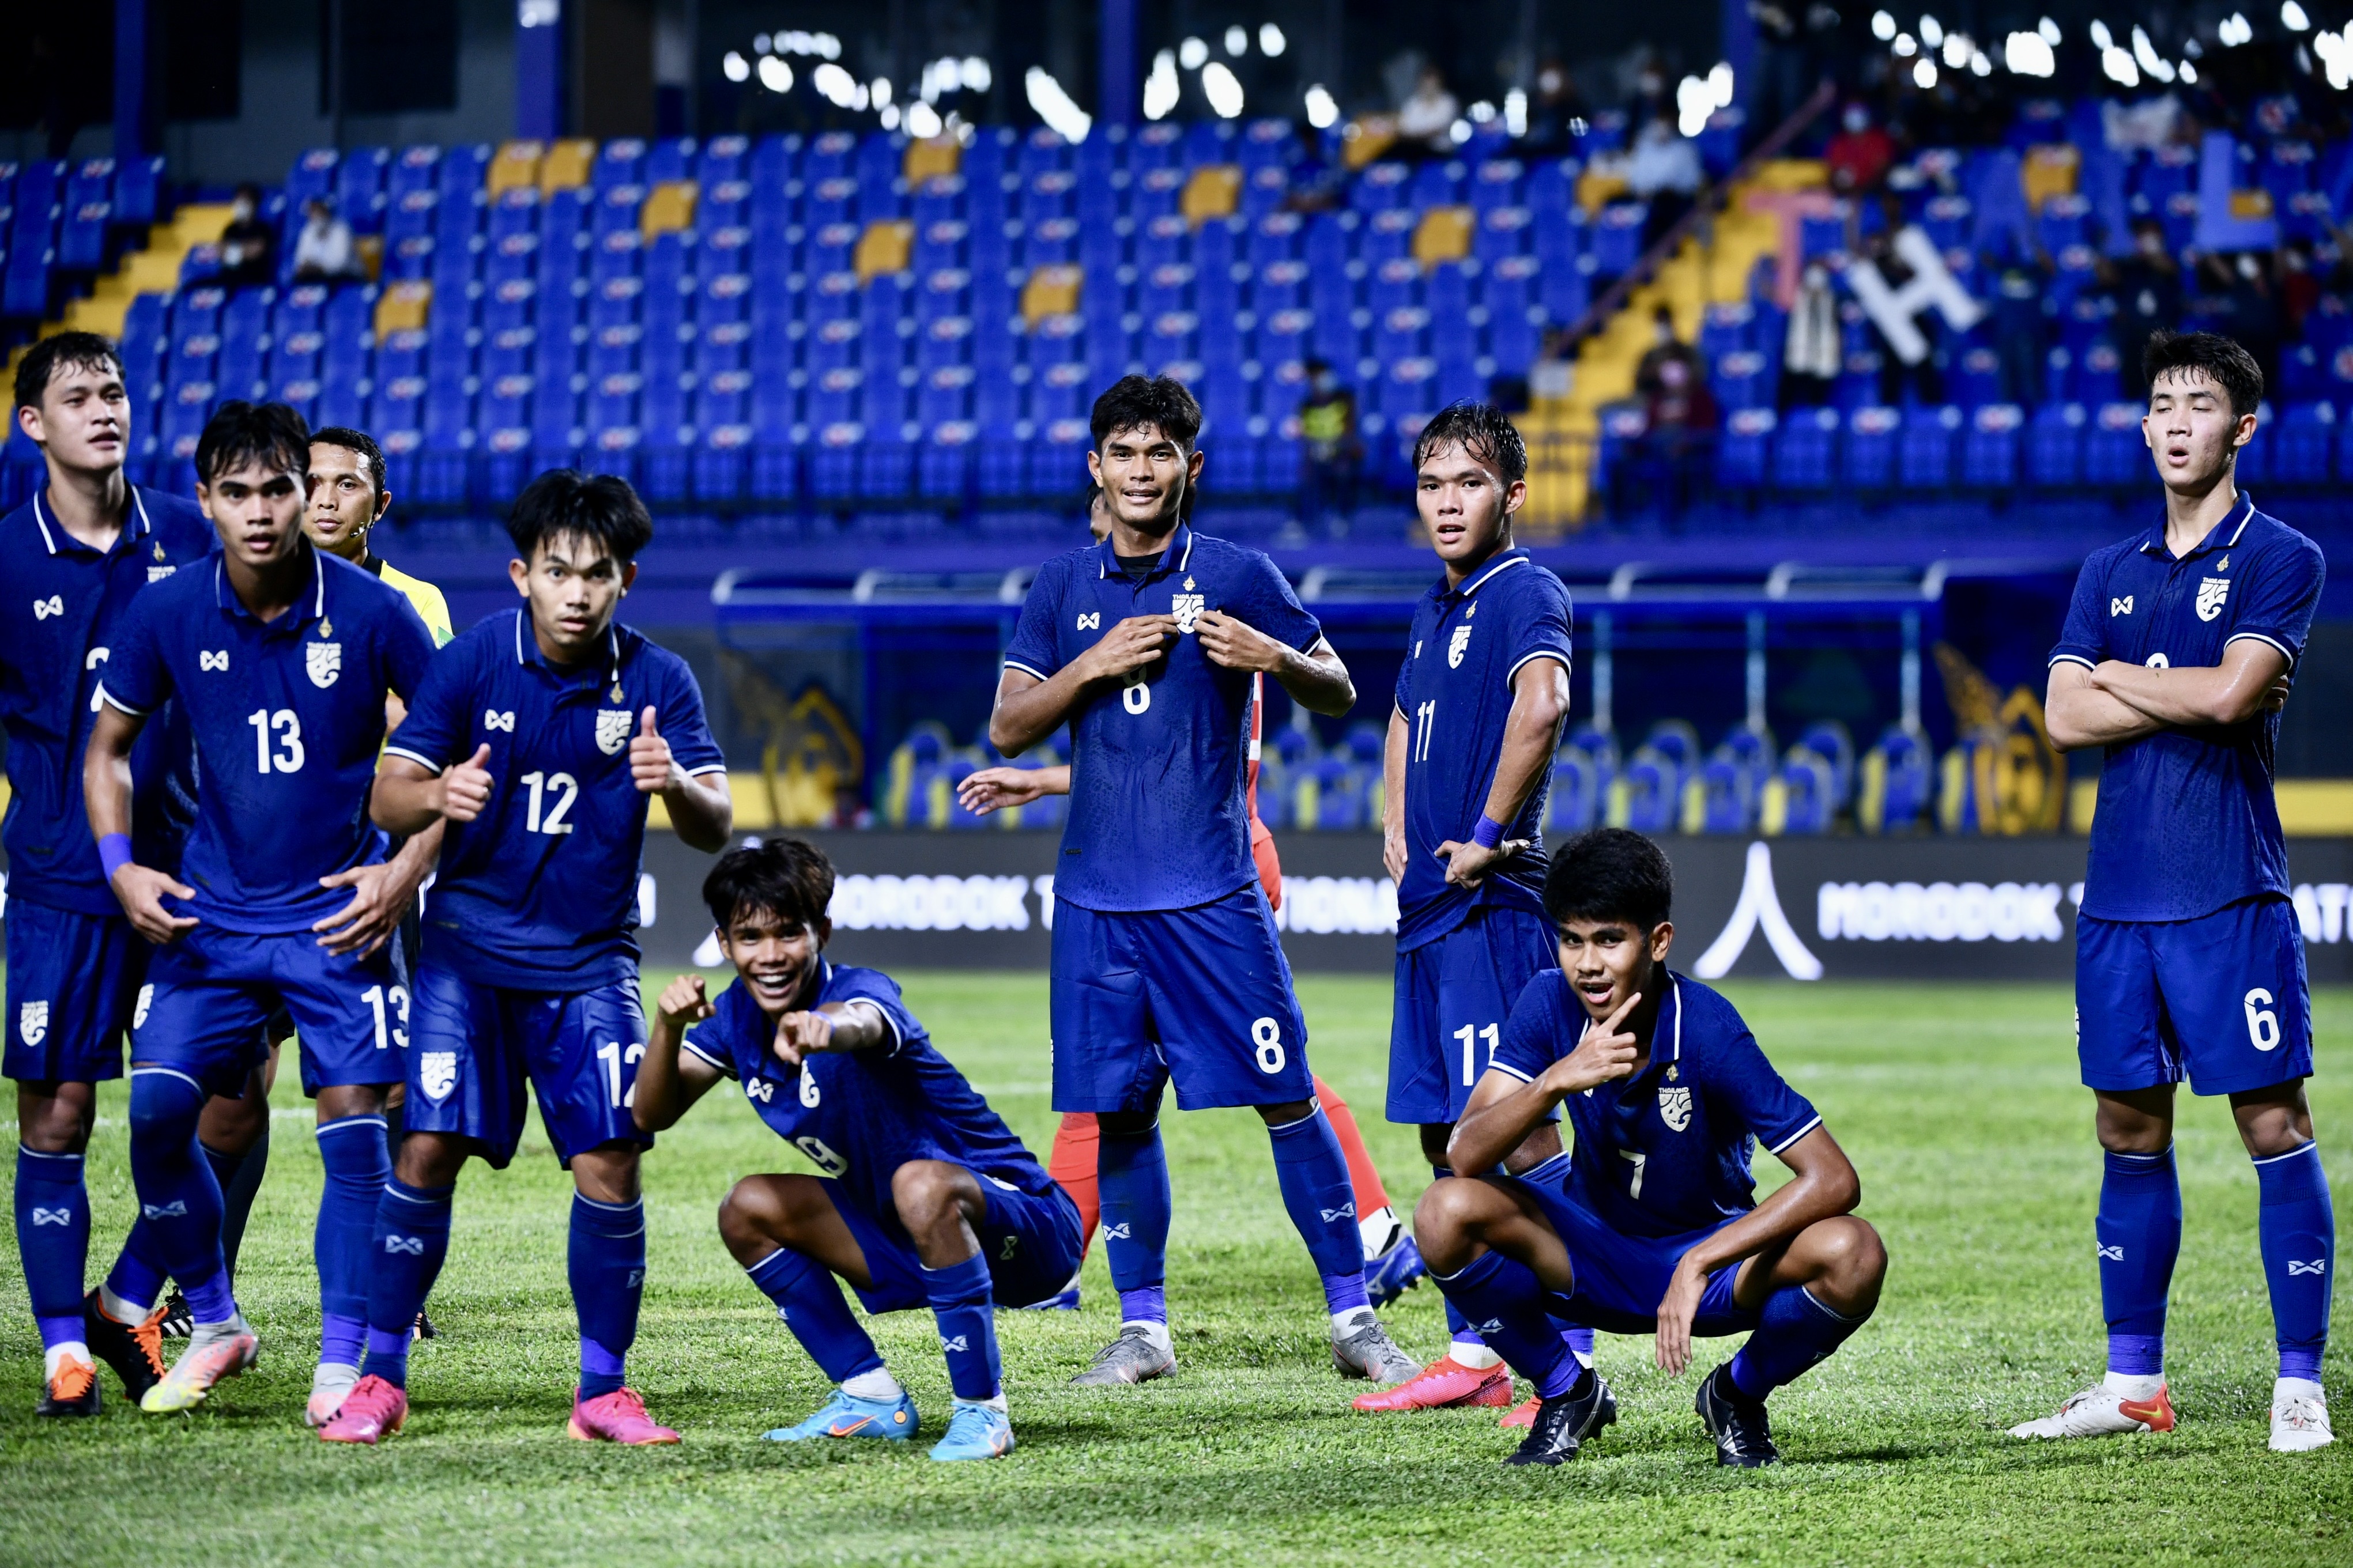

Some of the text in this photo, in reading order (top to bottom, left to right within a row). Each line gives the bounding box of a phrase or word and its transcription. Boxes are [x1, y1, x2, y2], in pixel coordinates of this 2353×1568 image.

[1847, 225, 1984, 367] H
[248, 709, 305, 774] 13
[1415, 699, 1436, 763] 11
[520, 771, 578, 834] 12
[360, 984, 410, 1049] 13
[1250, 1017, 1286, 1075] 8
[2243, 988, 2281, 1052] 6
[1453, 1023, 1499, 1087] 11
[1619, 1148, 1646, 1200] 7
